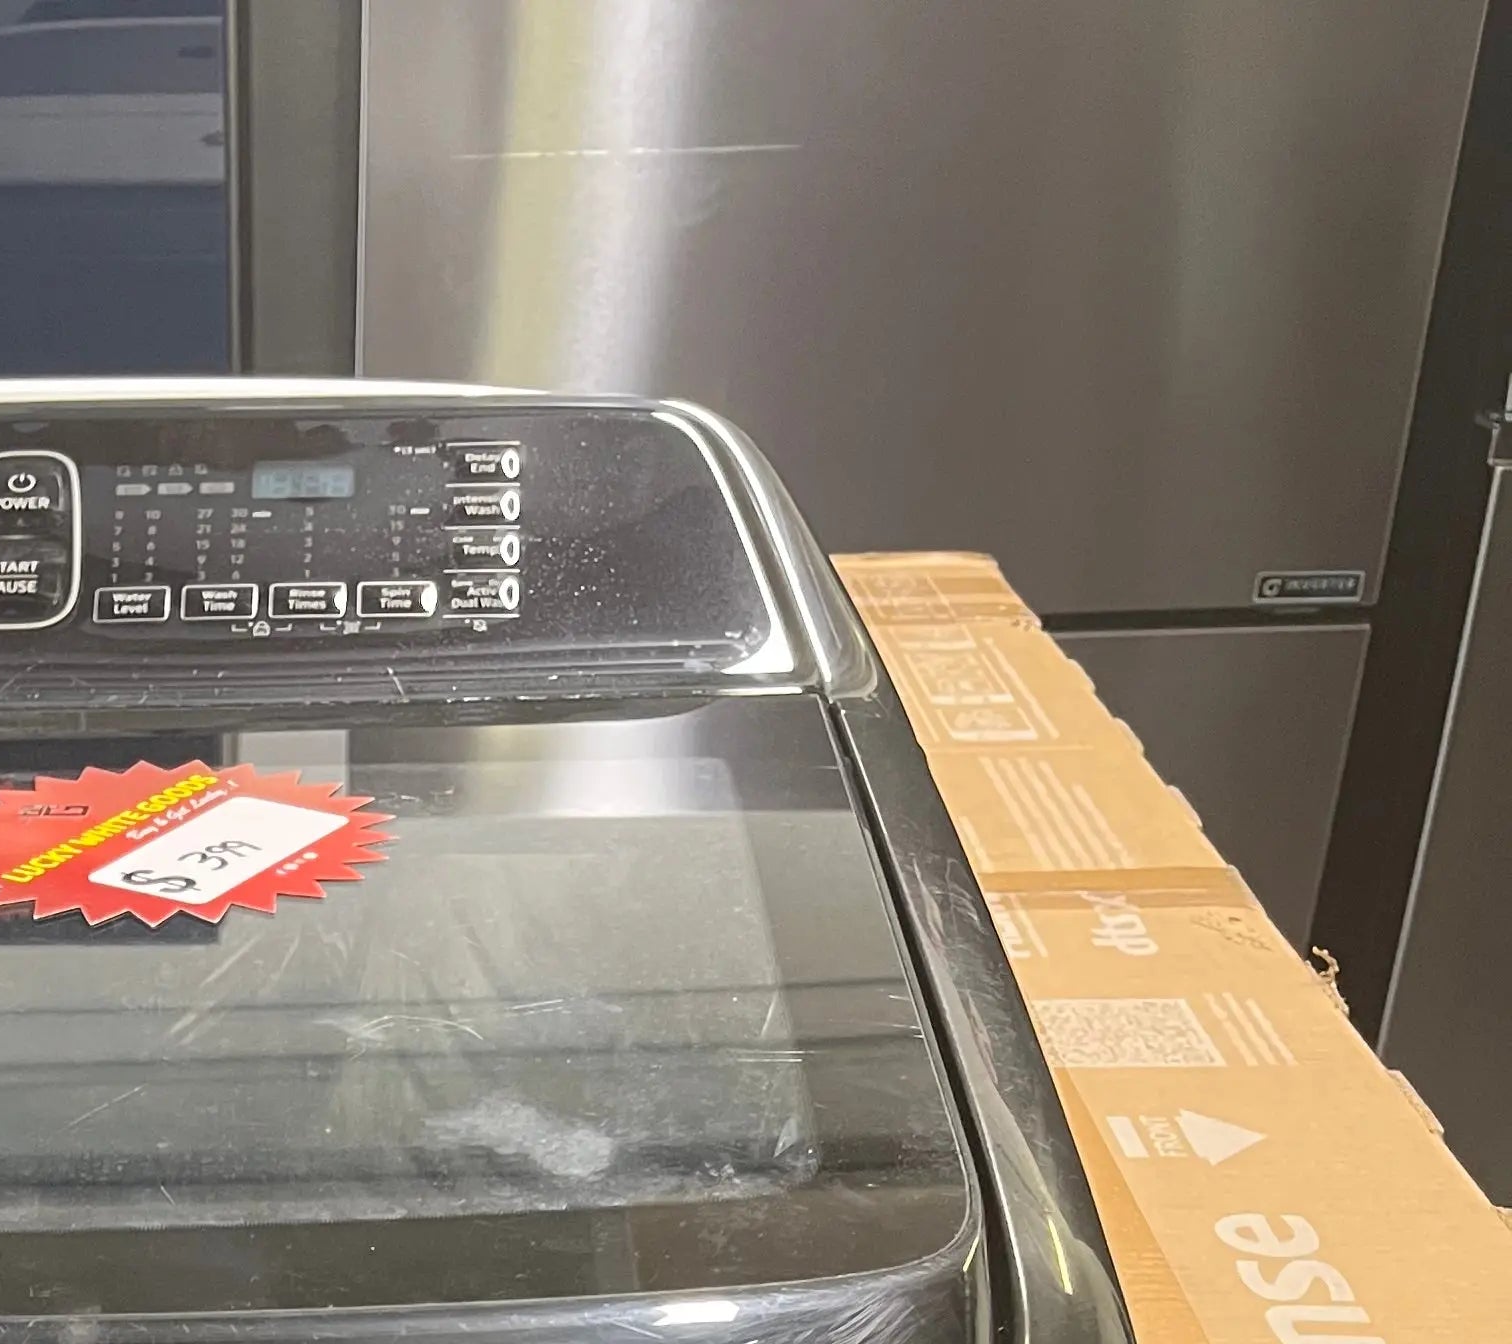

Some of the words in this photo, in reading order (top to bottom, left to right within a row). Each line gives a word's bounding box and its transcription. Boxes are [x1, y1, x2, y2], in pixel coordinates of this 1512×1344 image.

[112, 593, 152, 602] Water
[202, 590, 238, 600] Wash
[290, 589, 326, 598] Rinse
[381, 588, 411, 598] Spin
[113, 603, 149, 615] Level
[203, 601, 235, 612] Time
[289, 599, 327, 611] Times
[380, 598, 412, 609] Time
[451, 598, 478, 609] Dual
[1, 844, 83, 882] LUCKY
[69, 809, 151, 847] WHITE
[136, 774, 219, 812] GOODS
[121, 869, 202, 893] $
[177, 840, 263, 871] 399
